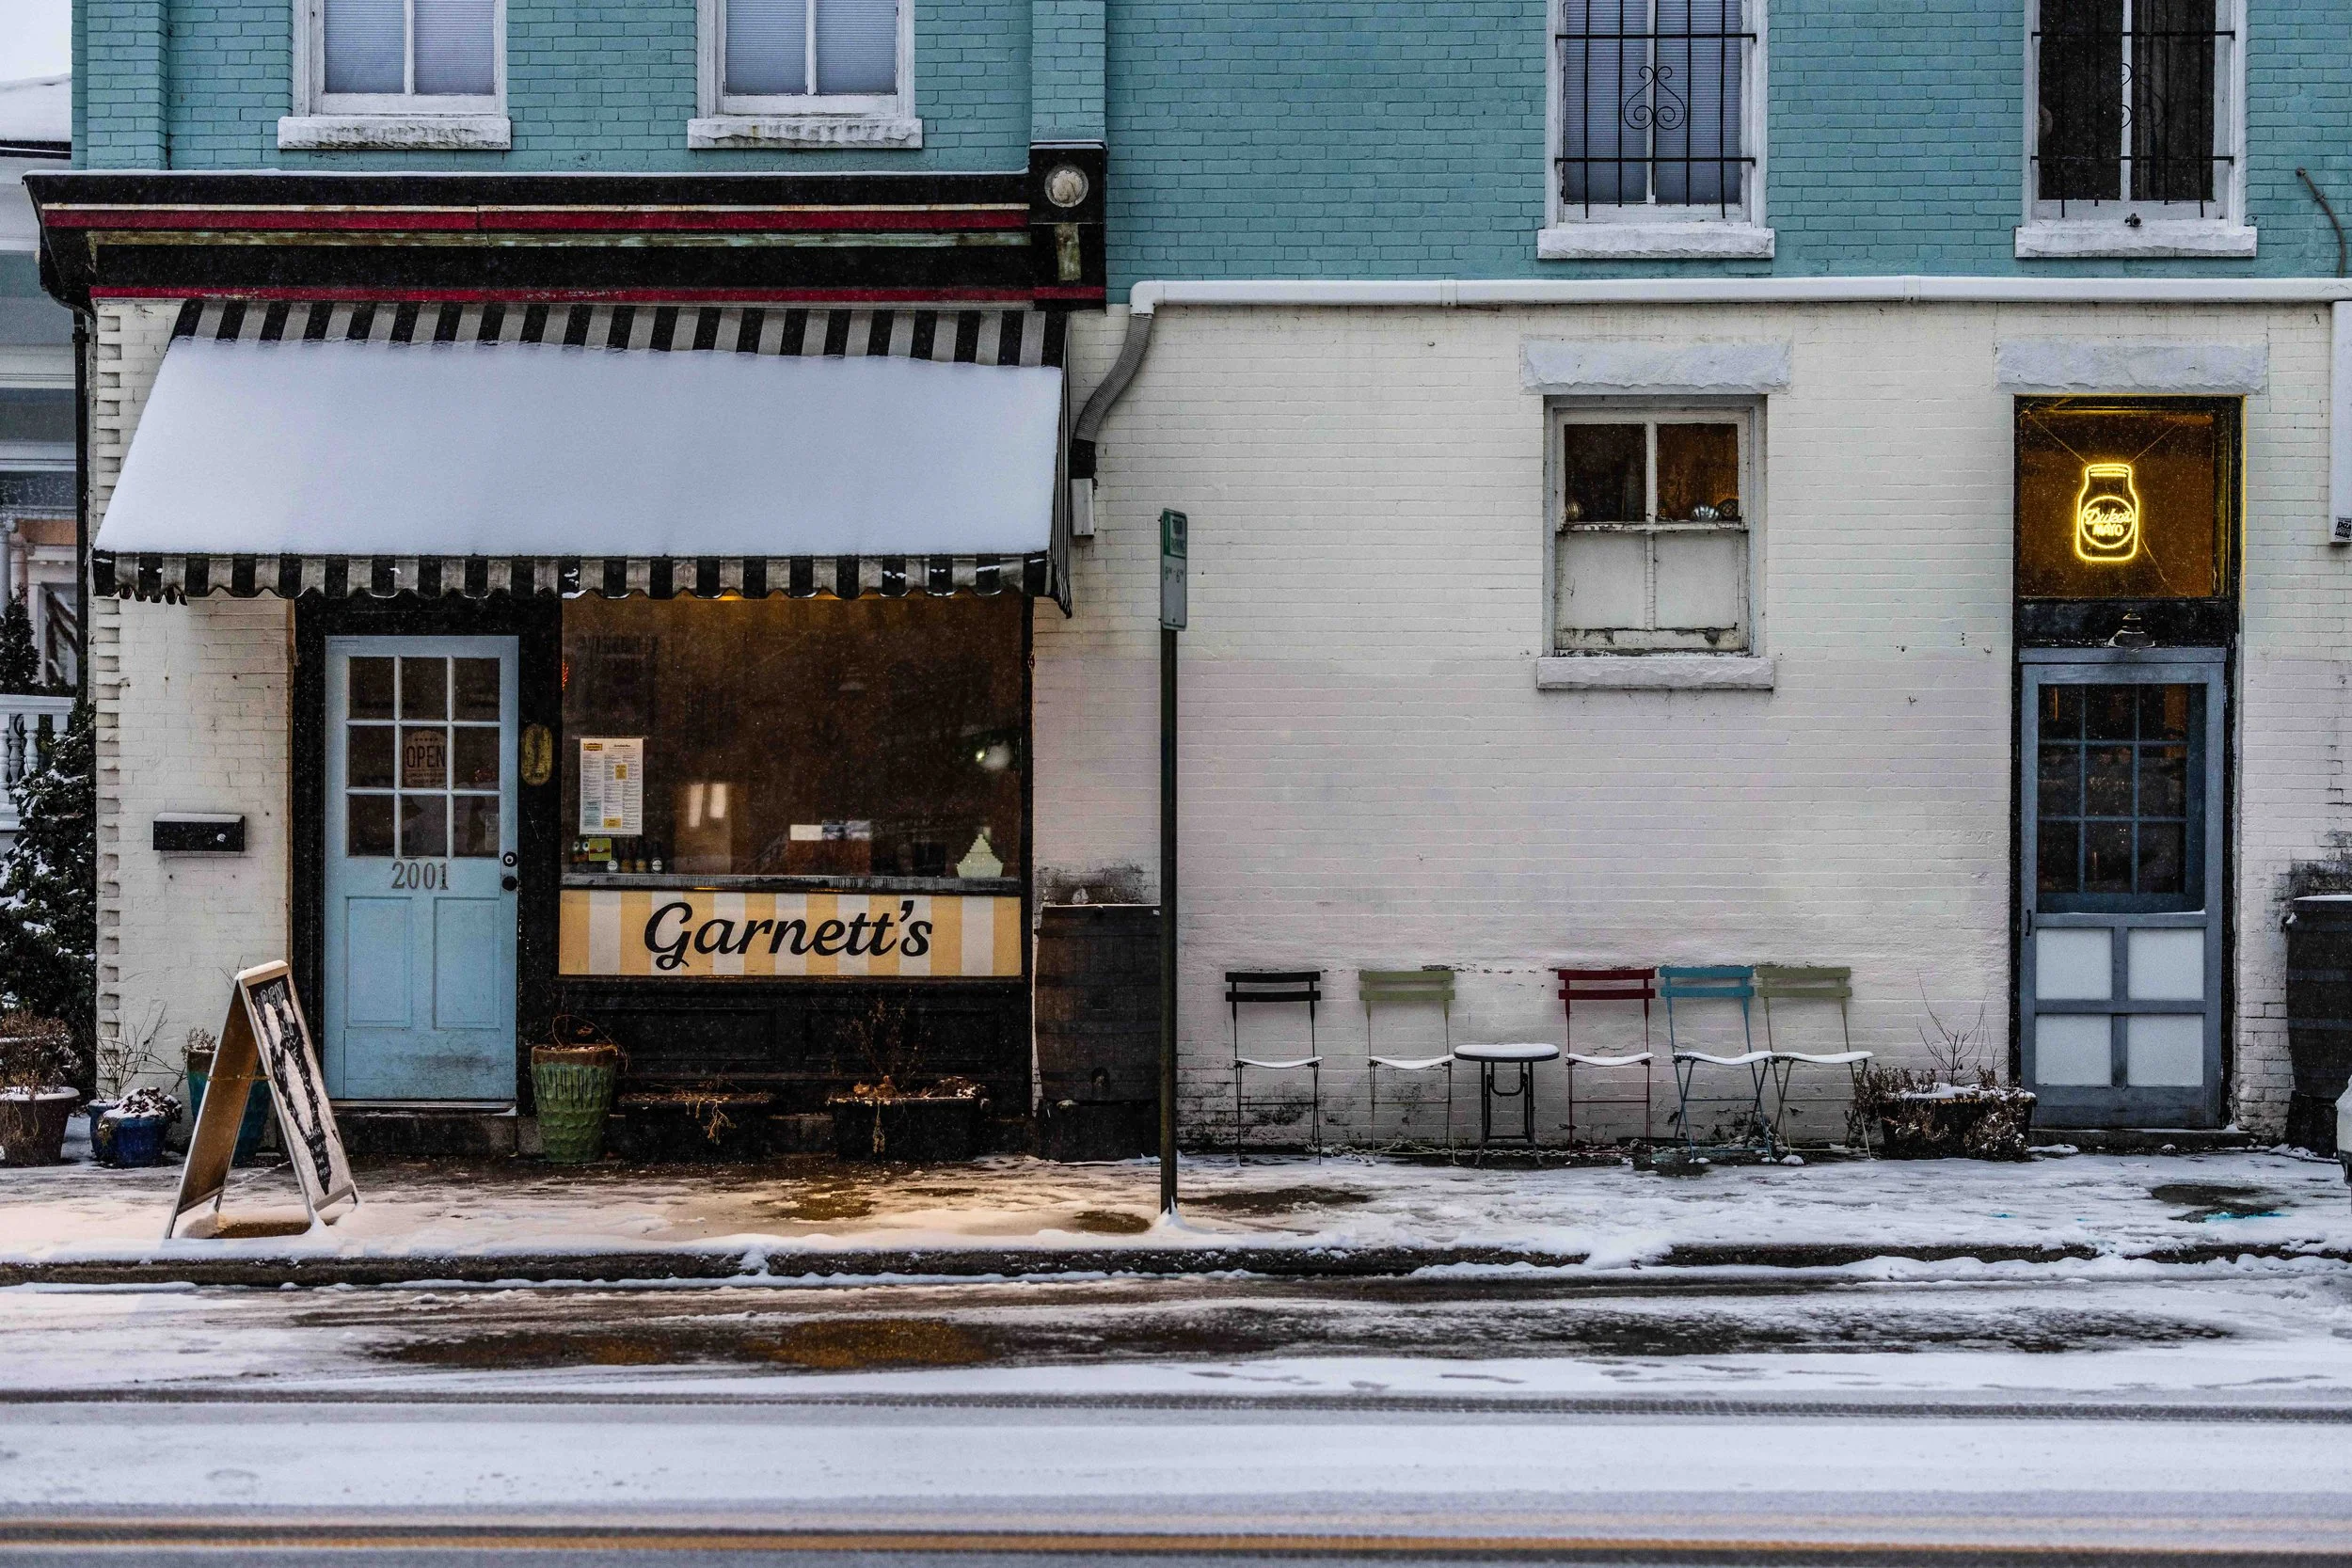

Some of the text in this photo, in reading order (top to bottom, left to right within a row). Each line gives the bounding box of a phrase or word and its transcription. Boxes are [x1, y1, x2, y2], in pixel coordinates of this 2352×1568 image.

[2084, 507, 2133, 525] Duke's
[2092, 523, 2124, 537] MAYO
[406, 746, 446, 768] OPEN
[391, 862, 449, 890] 2001
[644, 900, 933, 971] Garnett's
